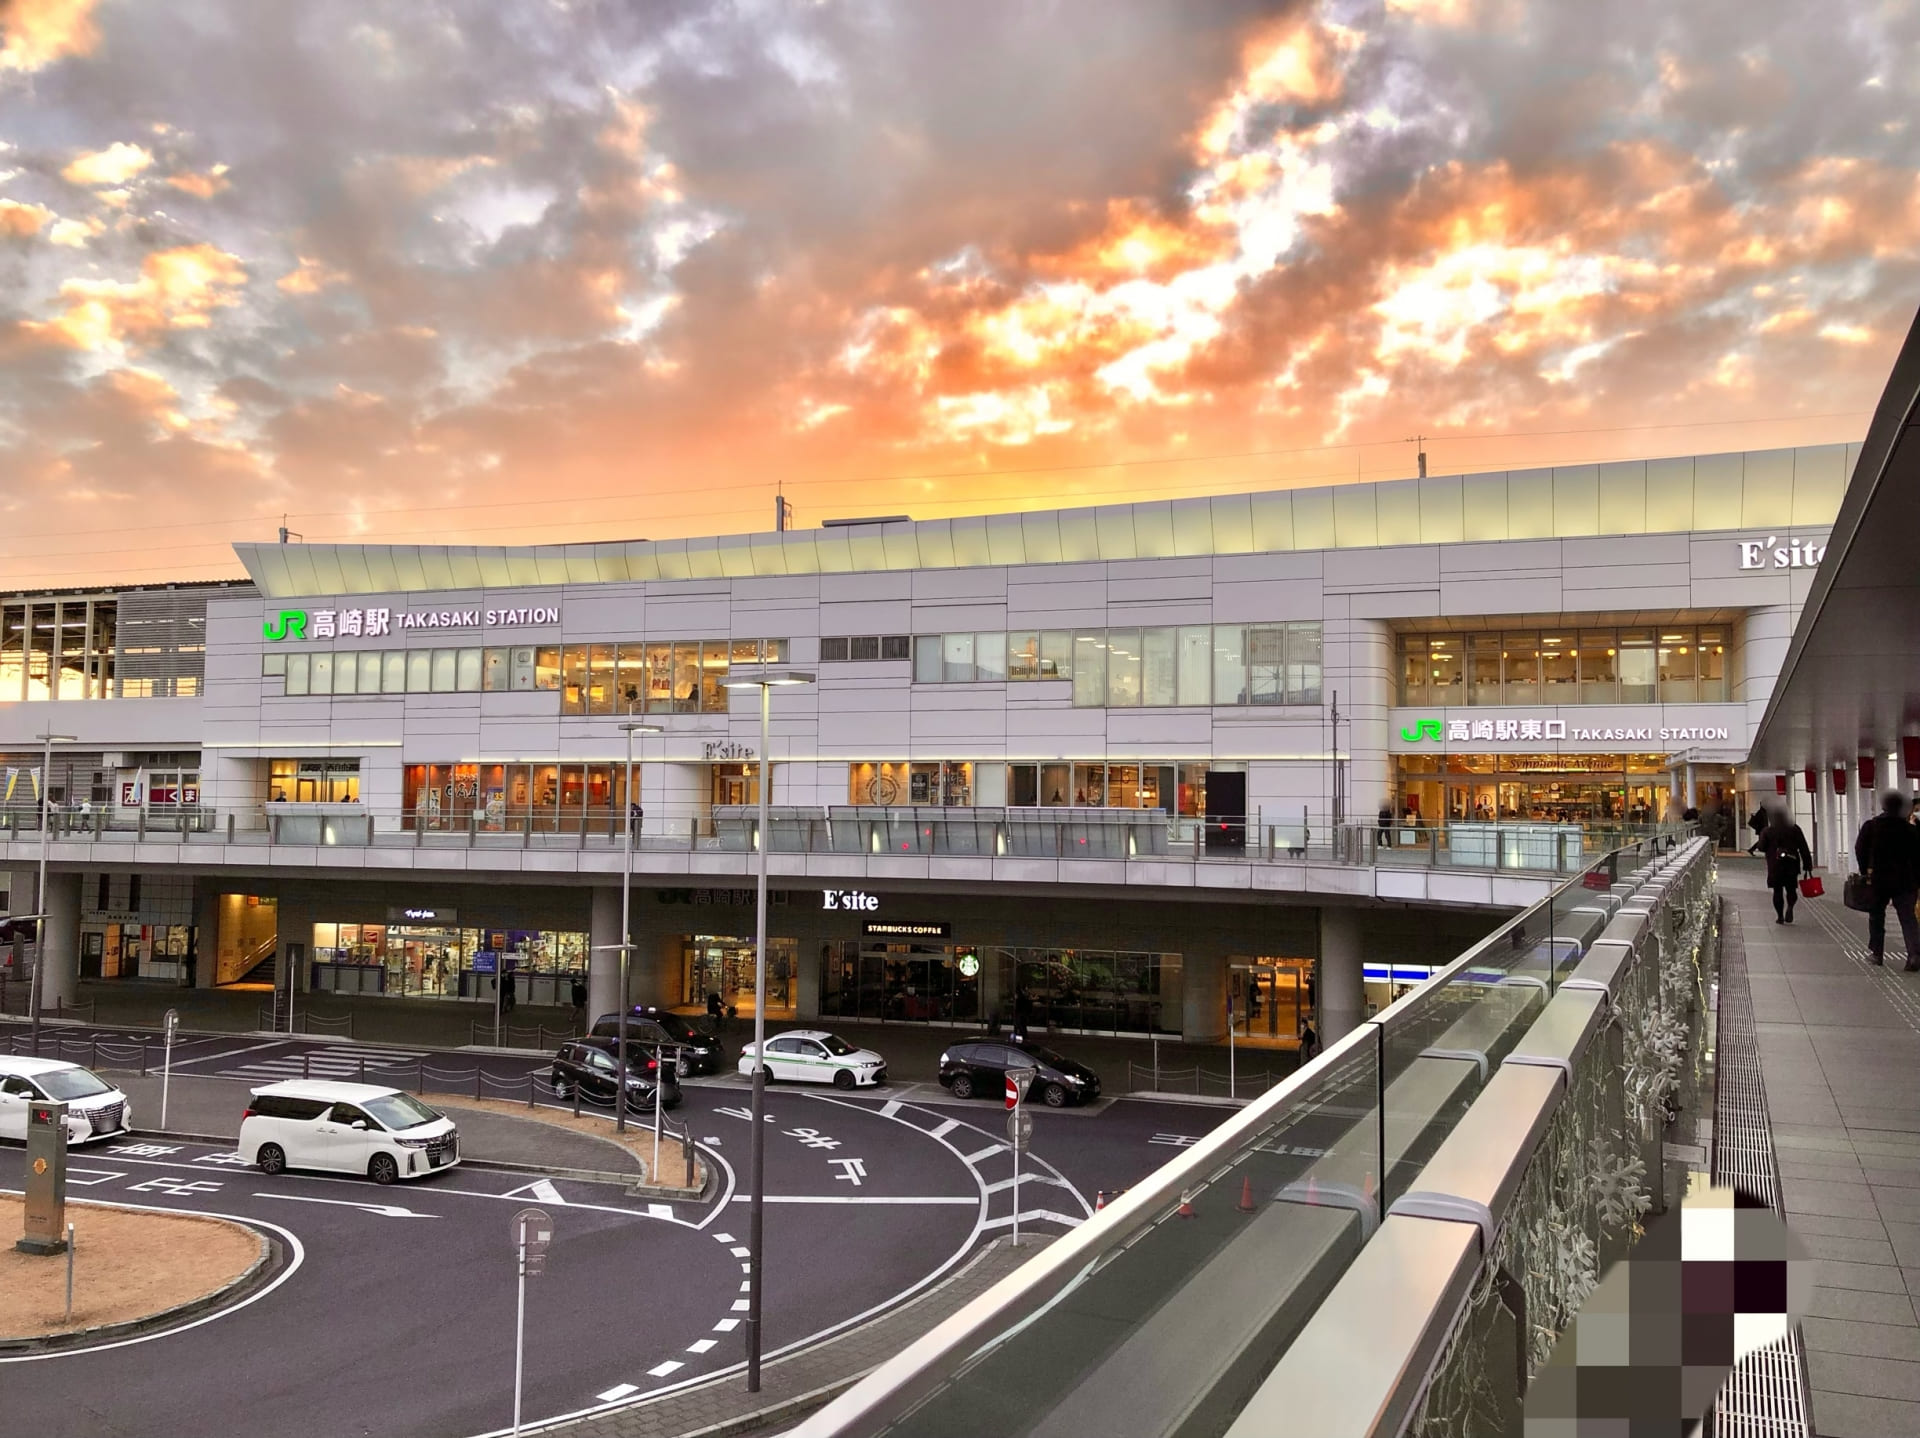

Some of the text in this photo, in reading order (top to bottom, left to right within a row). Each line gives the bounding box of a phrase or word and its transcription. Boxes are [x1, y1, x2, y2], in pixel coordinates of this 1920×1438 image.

[264, 607, 560, 640] JR 高崎駅 TAKASAKI STATION
[1401, 719, 1729, 742] JR 高崎駅東口 TAKASAKI STATION
[1509, 759, 1614, 769] Symphonic Avenue
[696, 889, 789, 905] 高崎駅口
[822, 889, 879, 911] E'site
[867, 925, 942, 934] STARBUCKS COFFEE
